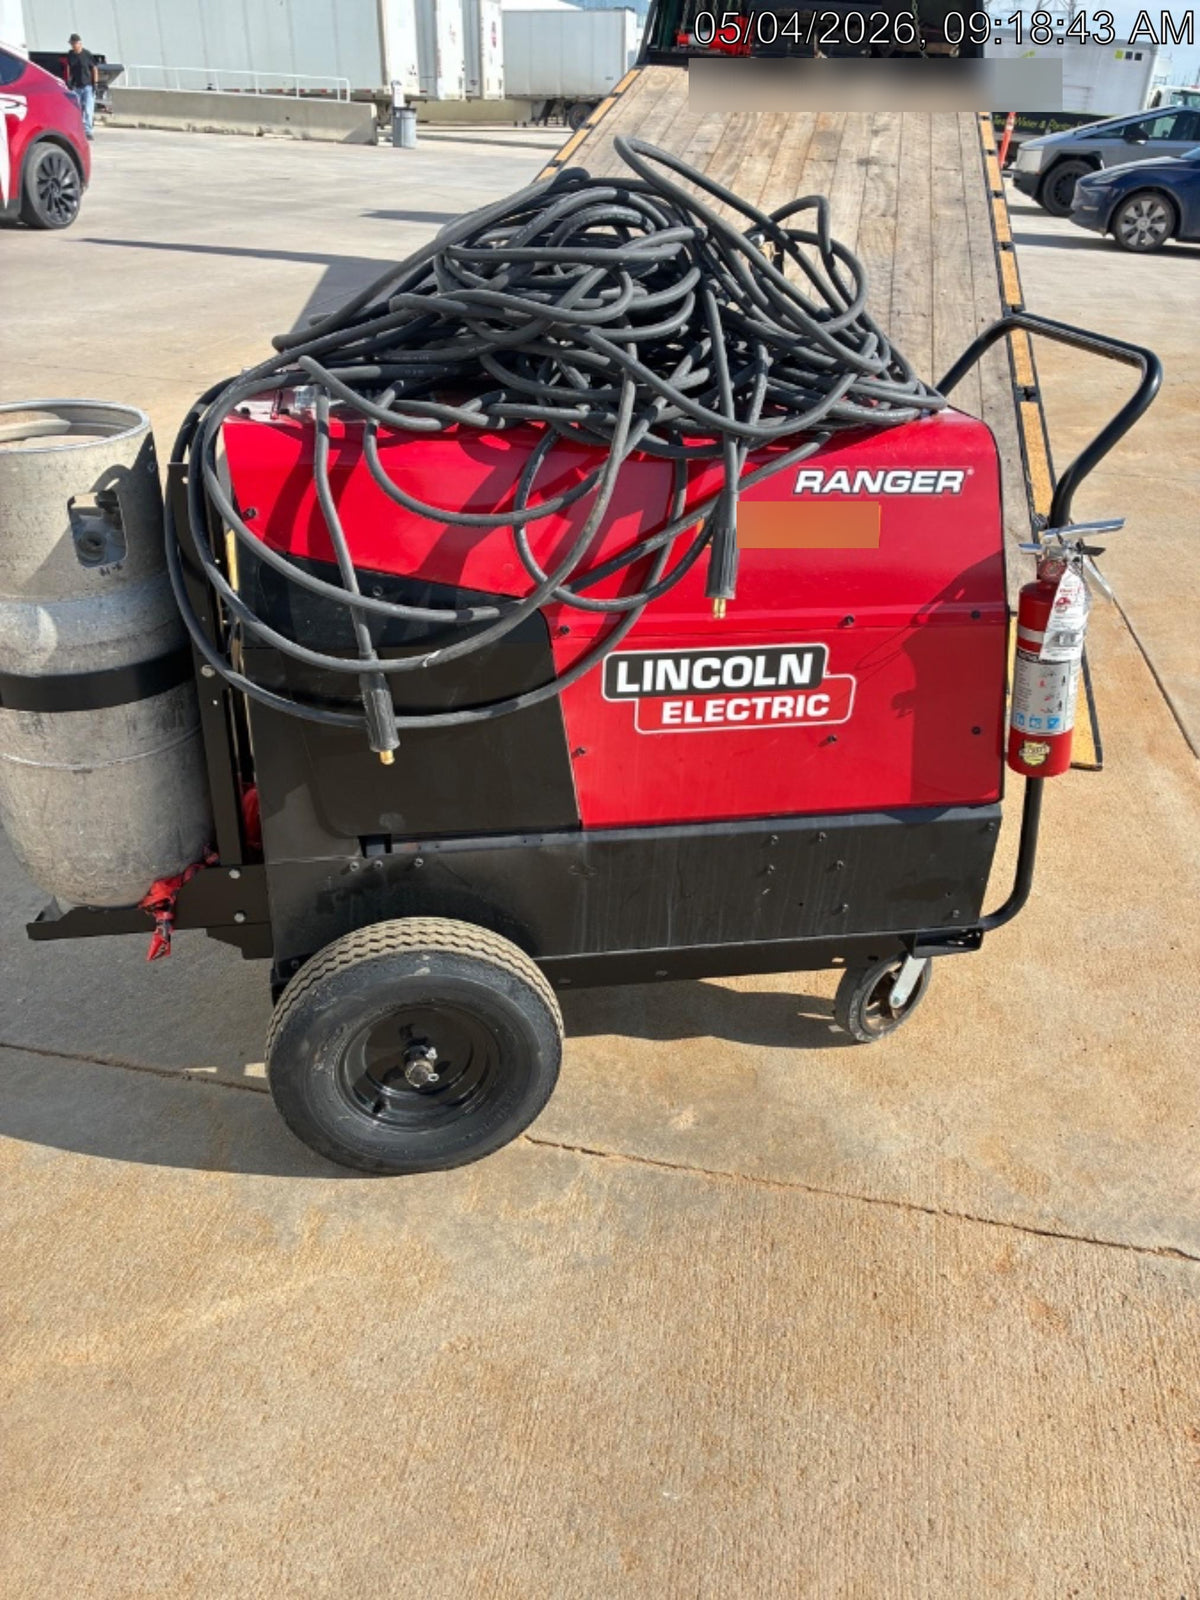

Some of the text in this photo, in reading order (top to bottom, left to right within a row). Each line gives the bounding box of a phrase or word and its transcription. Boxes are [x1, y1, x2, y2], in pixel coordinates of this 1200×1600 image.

[793, 469, 965, 494] RANGER
[616, 652, 814, 693] LINCOLN
[661, 693, 831, 725] ELECTRIC
